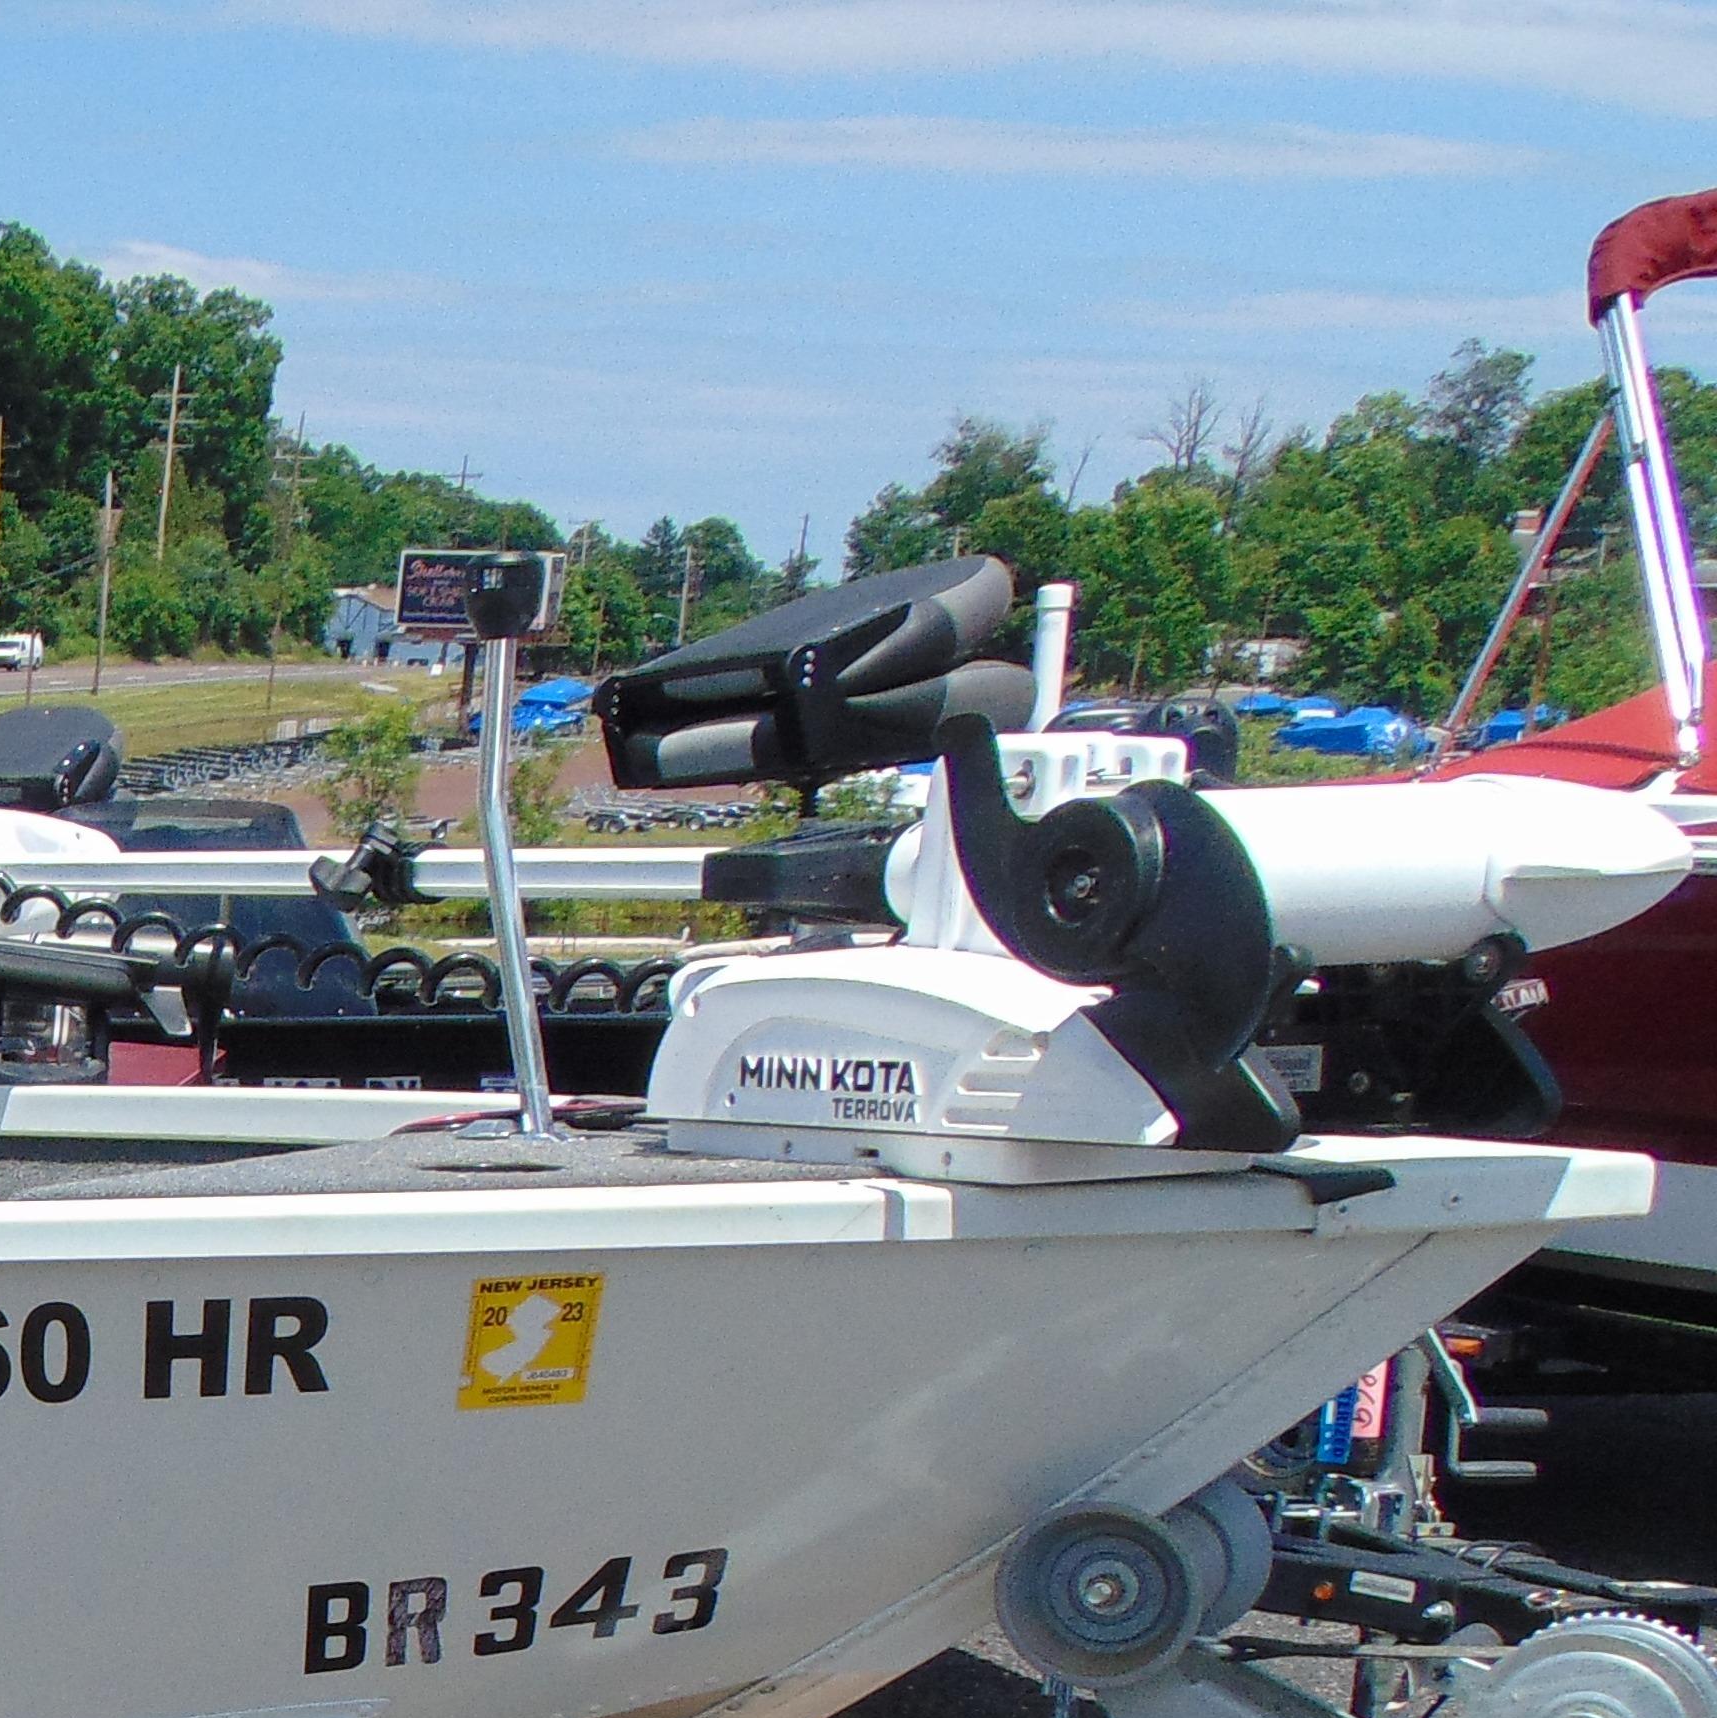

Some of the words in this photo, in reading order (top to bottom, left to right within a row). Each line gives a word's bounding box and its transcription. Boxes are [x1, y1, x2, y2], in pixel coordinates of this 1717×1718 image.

[740, 1055, 824, 1090] MINN
[830, 1058, 921, 1095] KOTA
[832, 1097, 920, 1123] TERROVA
[480, 1281, 522, 1293] NEW
[527, 1277, 599, 1290] JERSEY
[483, 1306, 508, 1327] 20
[561, 1302, 584, 1322] 23
[144, 1295, 330, 1399] HR
